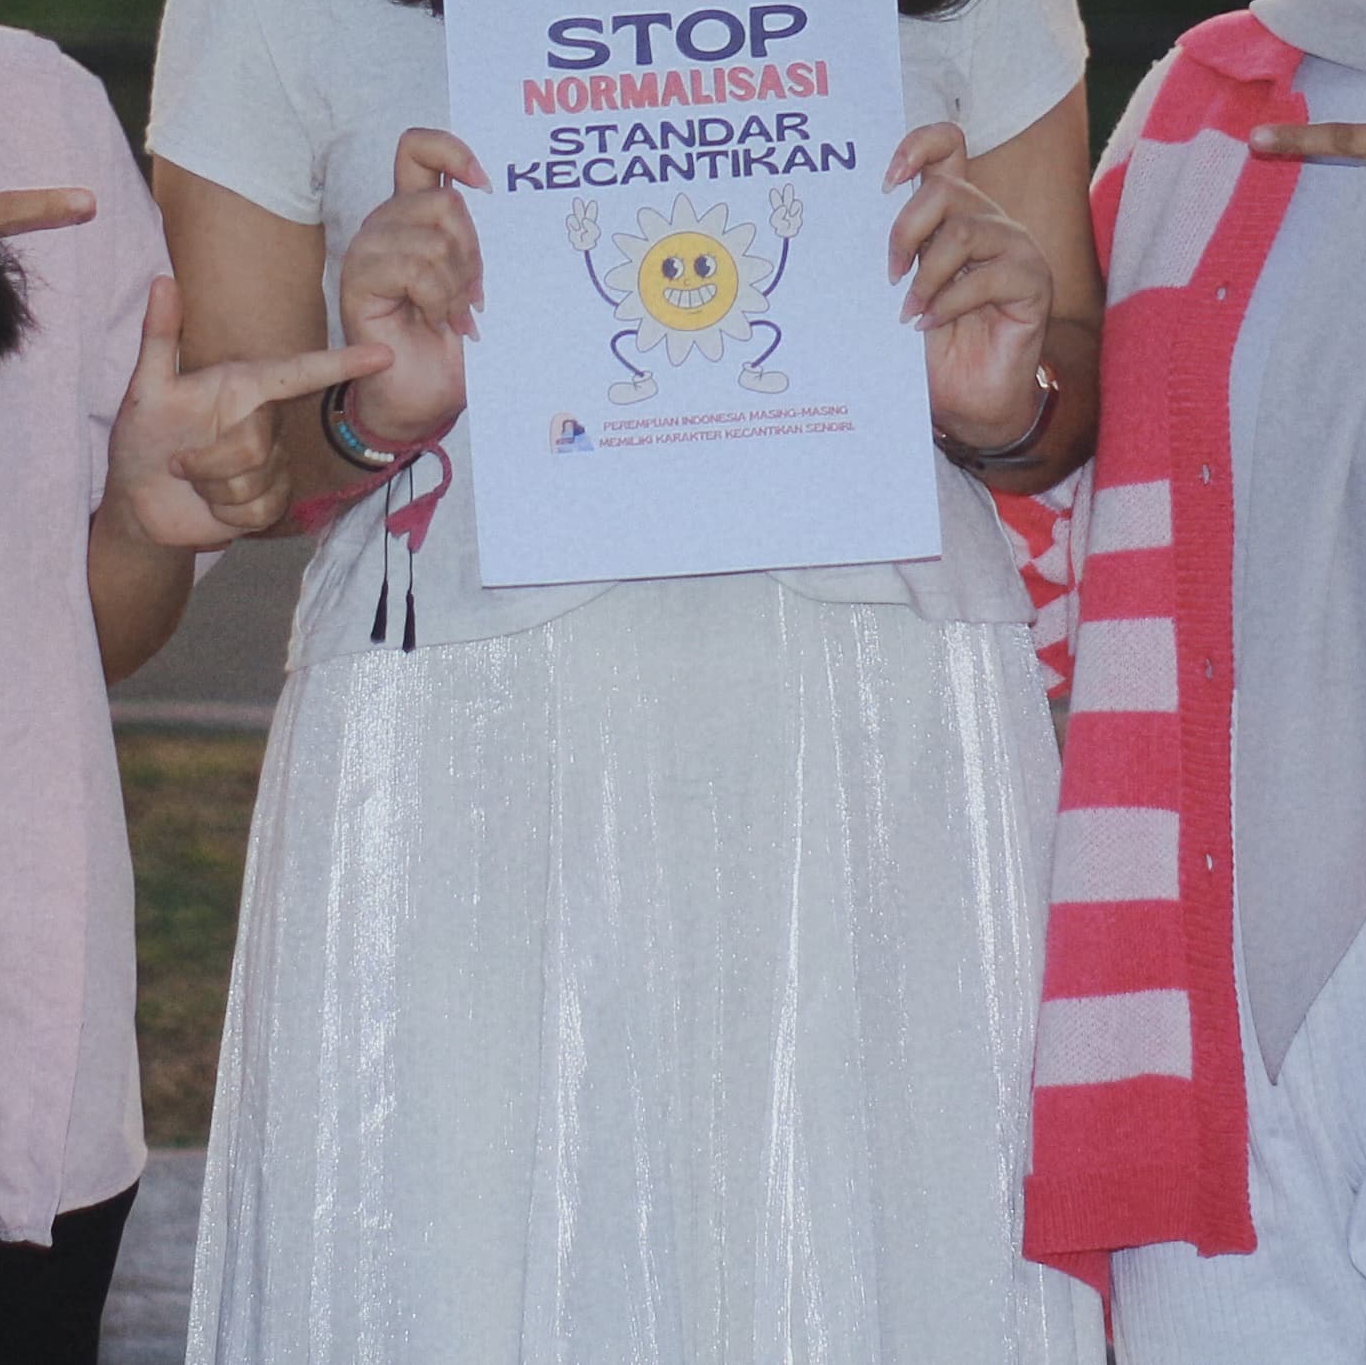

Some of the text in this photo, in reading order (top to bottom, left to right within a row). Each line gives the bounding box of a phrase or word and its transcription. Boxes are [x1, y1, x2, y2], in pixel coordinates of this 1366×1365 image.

[547, 4, 808, 70] STOP
[523, 60, 829, 115] NORMALISASI
[549, 112, 810, 156] STANDAR
[507, 141, 857, 192] KECANTIKAN
[599, 436, 653, 448] MEMILIKI
[656, 430, 722, 444] KARAKTER
[725, 425, 803, 440] KECANTIKAN
[603, 405, 848, 431] PEREMPUAN INDONESIA MASING-MASING
